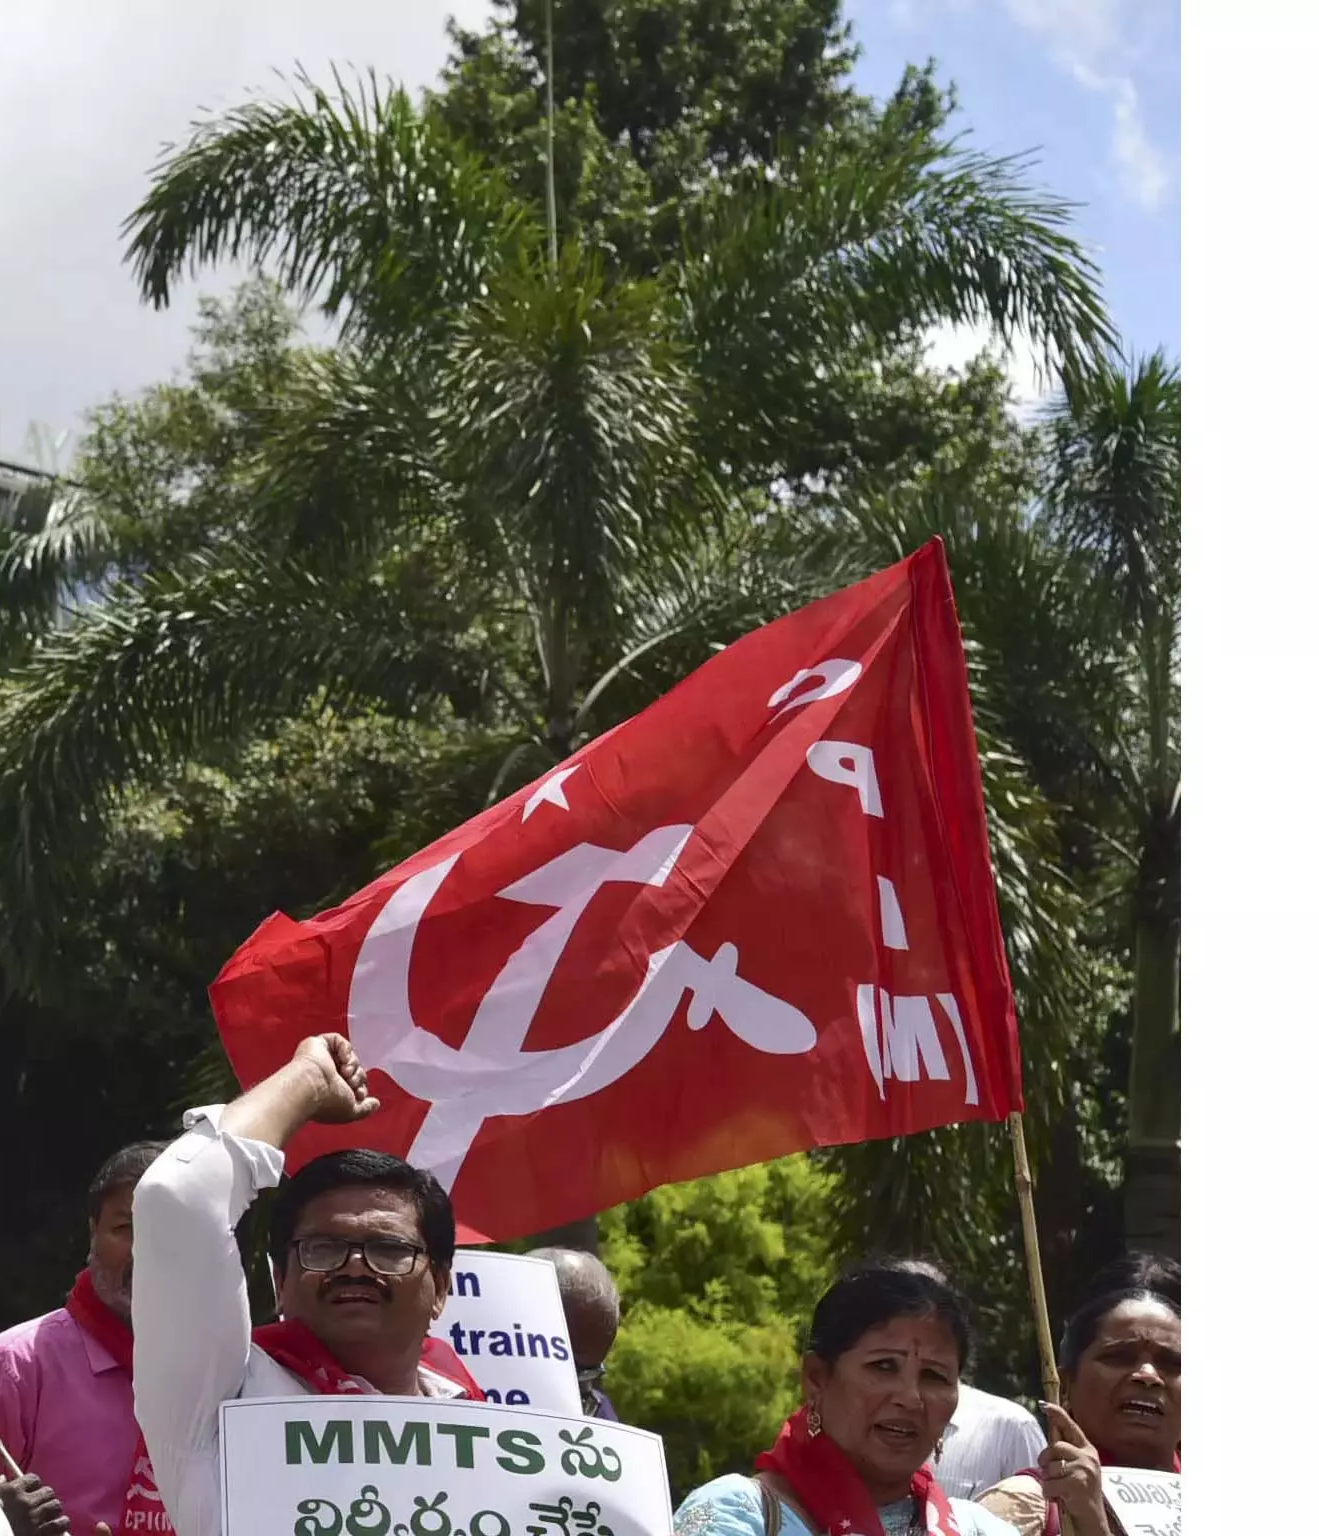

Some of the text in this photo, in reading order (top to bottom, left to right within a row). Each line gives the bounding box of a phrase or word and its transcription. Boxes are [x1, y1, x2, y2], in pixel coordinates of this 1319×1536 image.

[449, 1320, 569, 1361] trains
[284, 1420, 623, 1483] MMTS ను
